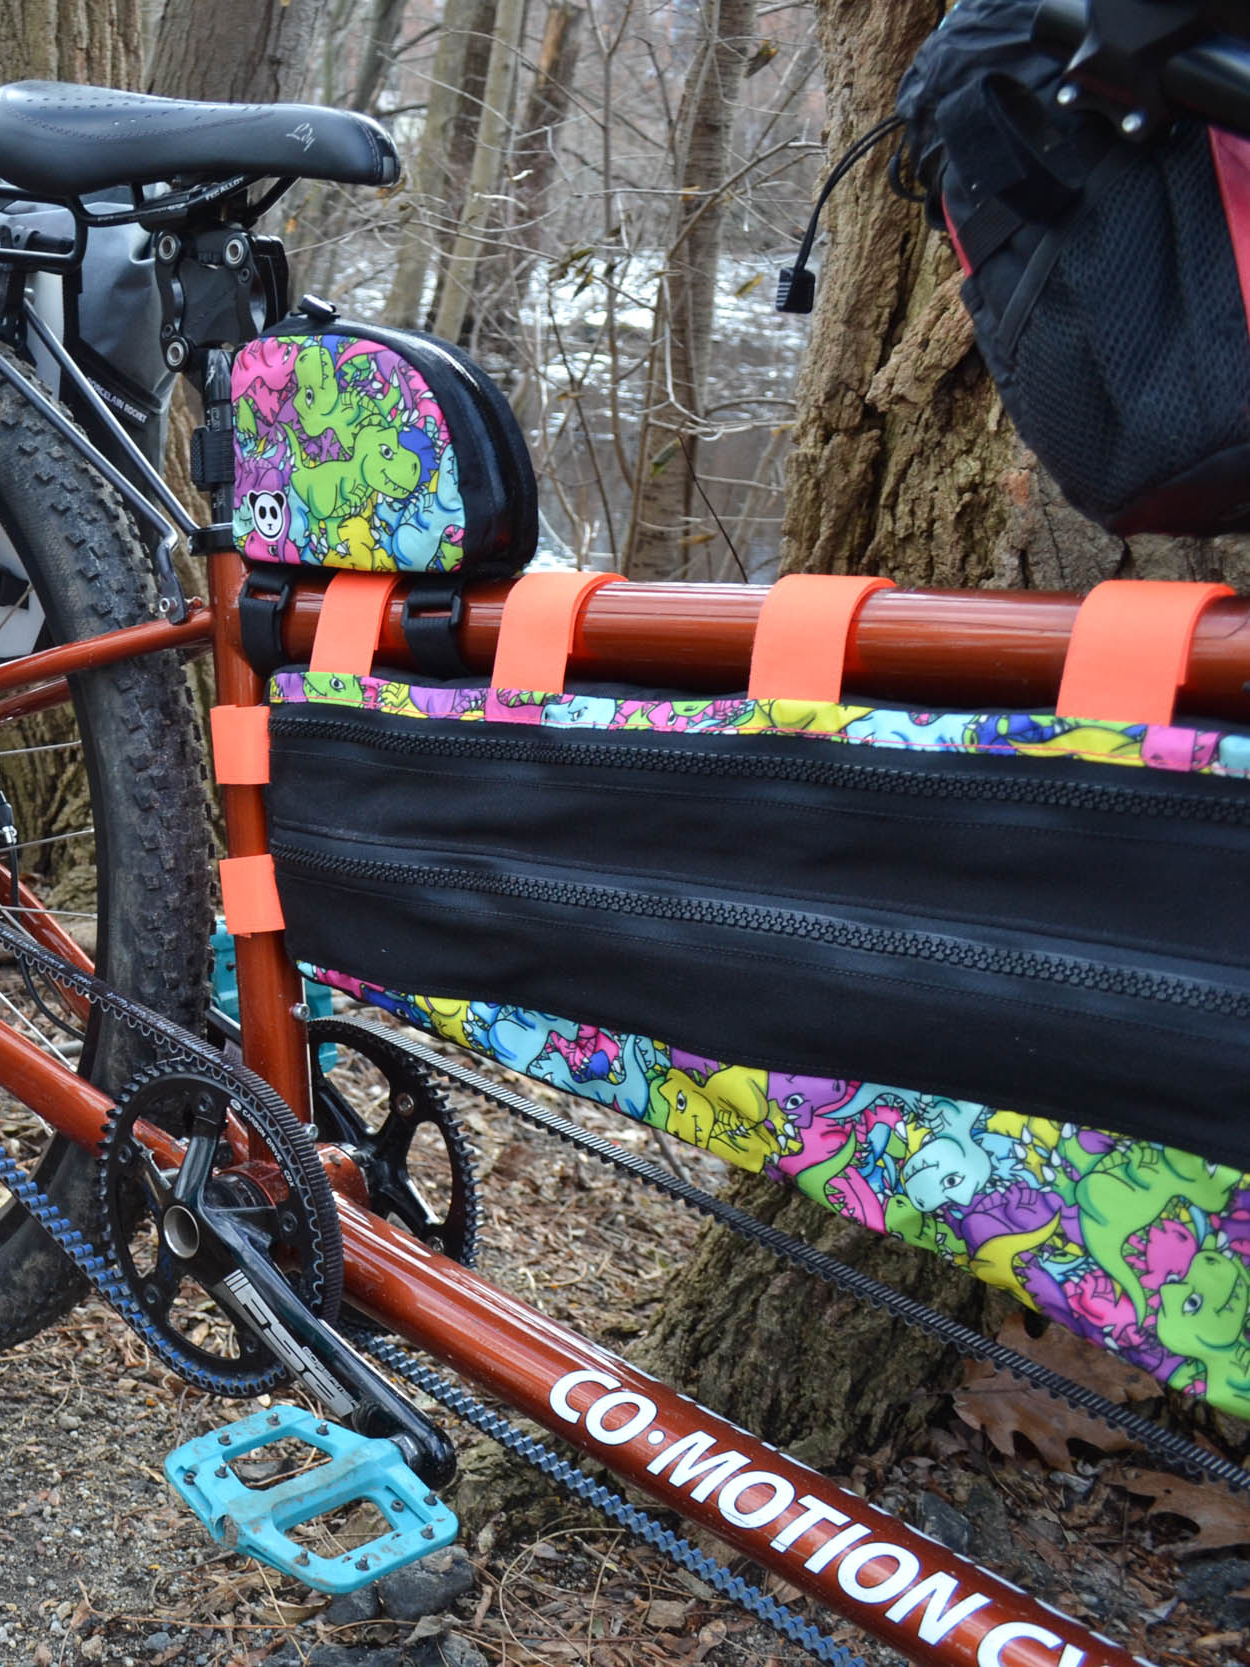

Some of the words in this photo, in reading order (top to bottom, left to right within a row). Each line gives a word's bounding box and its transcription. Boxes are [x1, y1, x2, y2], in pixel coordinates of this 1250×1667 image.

[124, 403, 148, 423] ROCKET
[242, 1110, 266, 1137] CARBON
[266, 1138, 283, 1162] DRIVE
